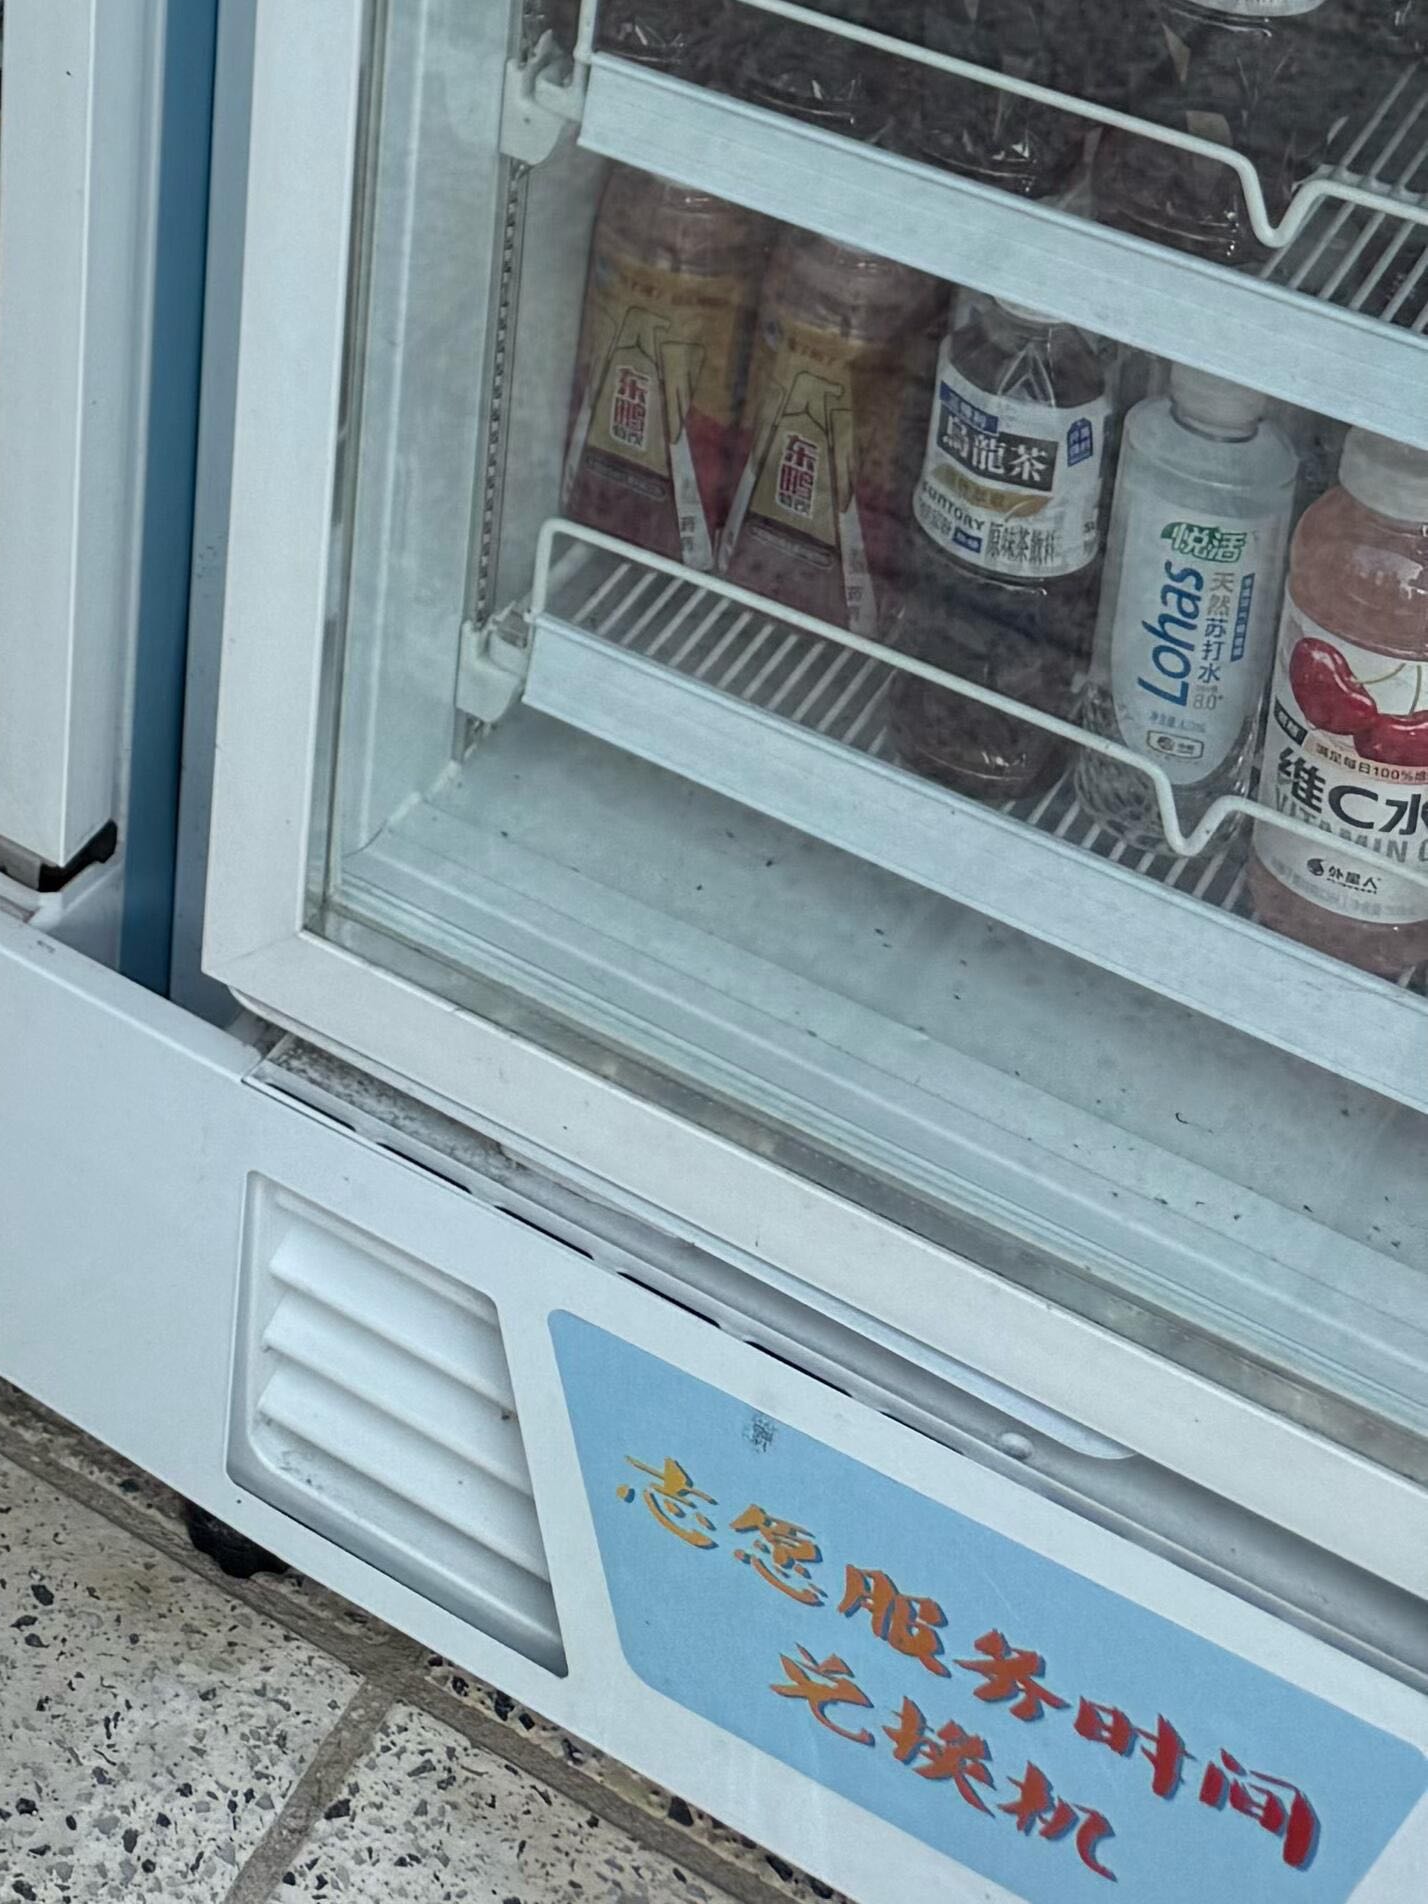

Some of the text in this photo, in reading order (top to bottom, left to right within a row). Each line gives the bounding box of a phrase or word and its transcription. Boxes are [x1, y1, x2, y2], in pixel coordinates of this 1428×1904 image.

[942, 415, 1049, 482] 烏龍茶
[1171, 522, 1246, 564] 悦活
[1137, 559, 1205, 707] Lohas
[1196, 572, 1236, 684] 天然苏打水
[1277, 745, 1428, 836] 维C水
[618, 1455, 1320, 1871] 志愿服务时间
[770, 1643, 1118, 1882] 兑换机
